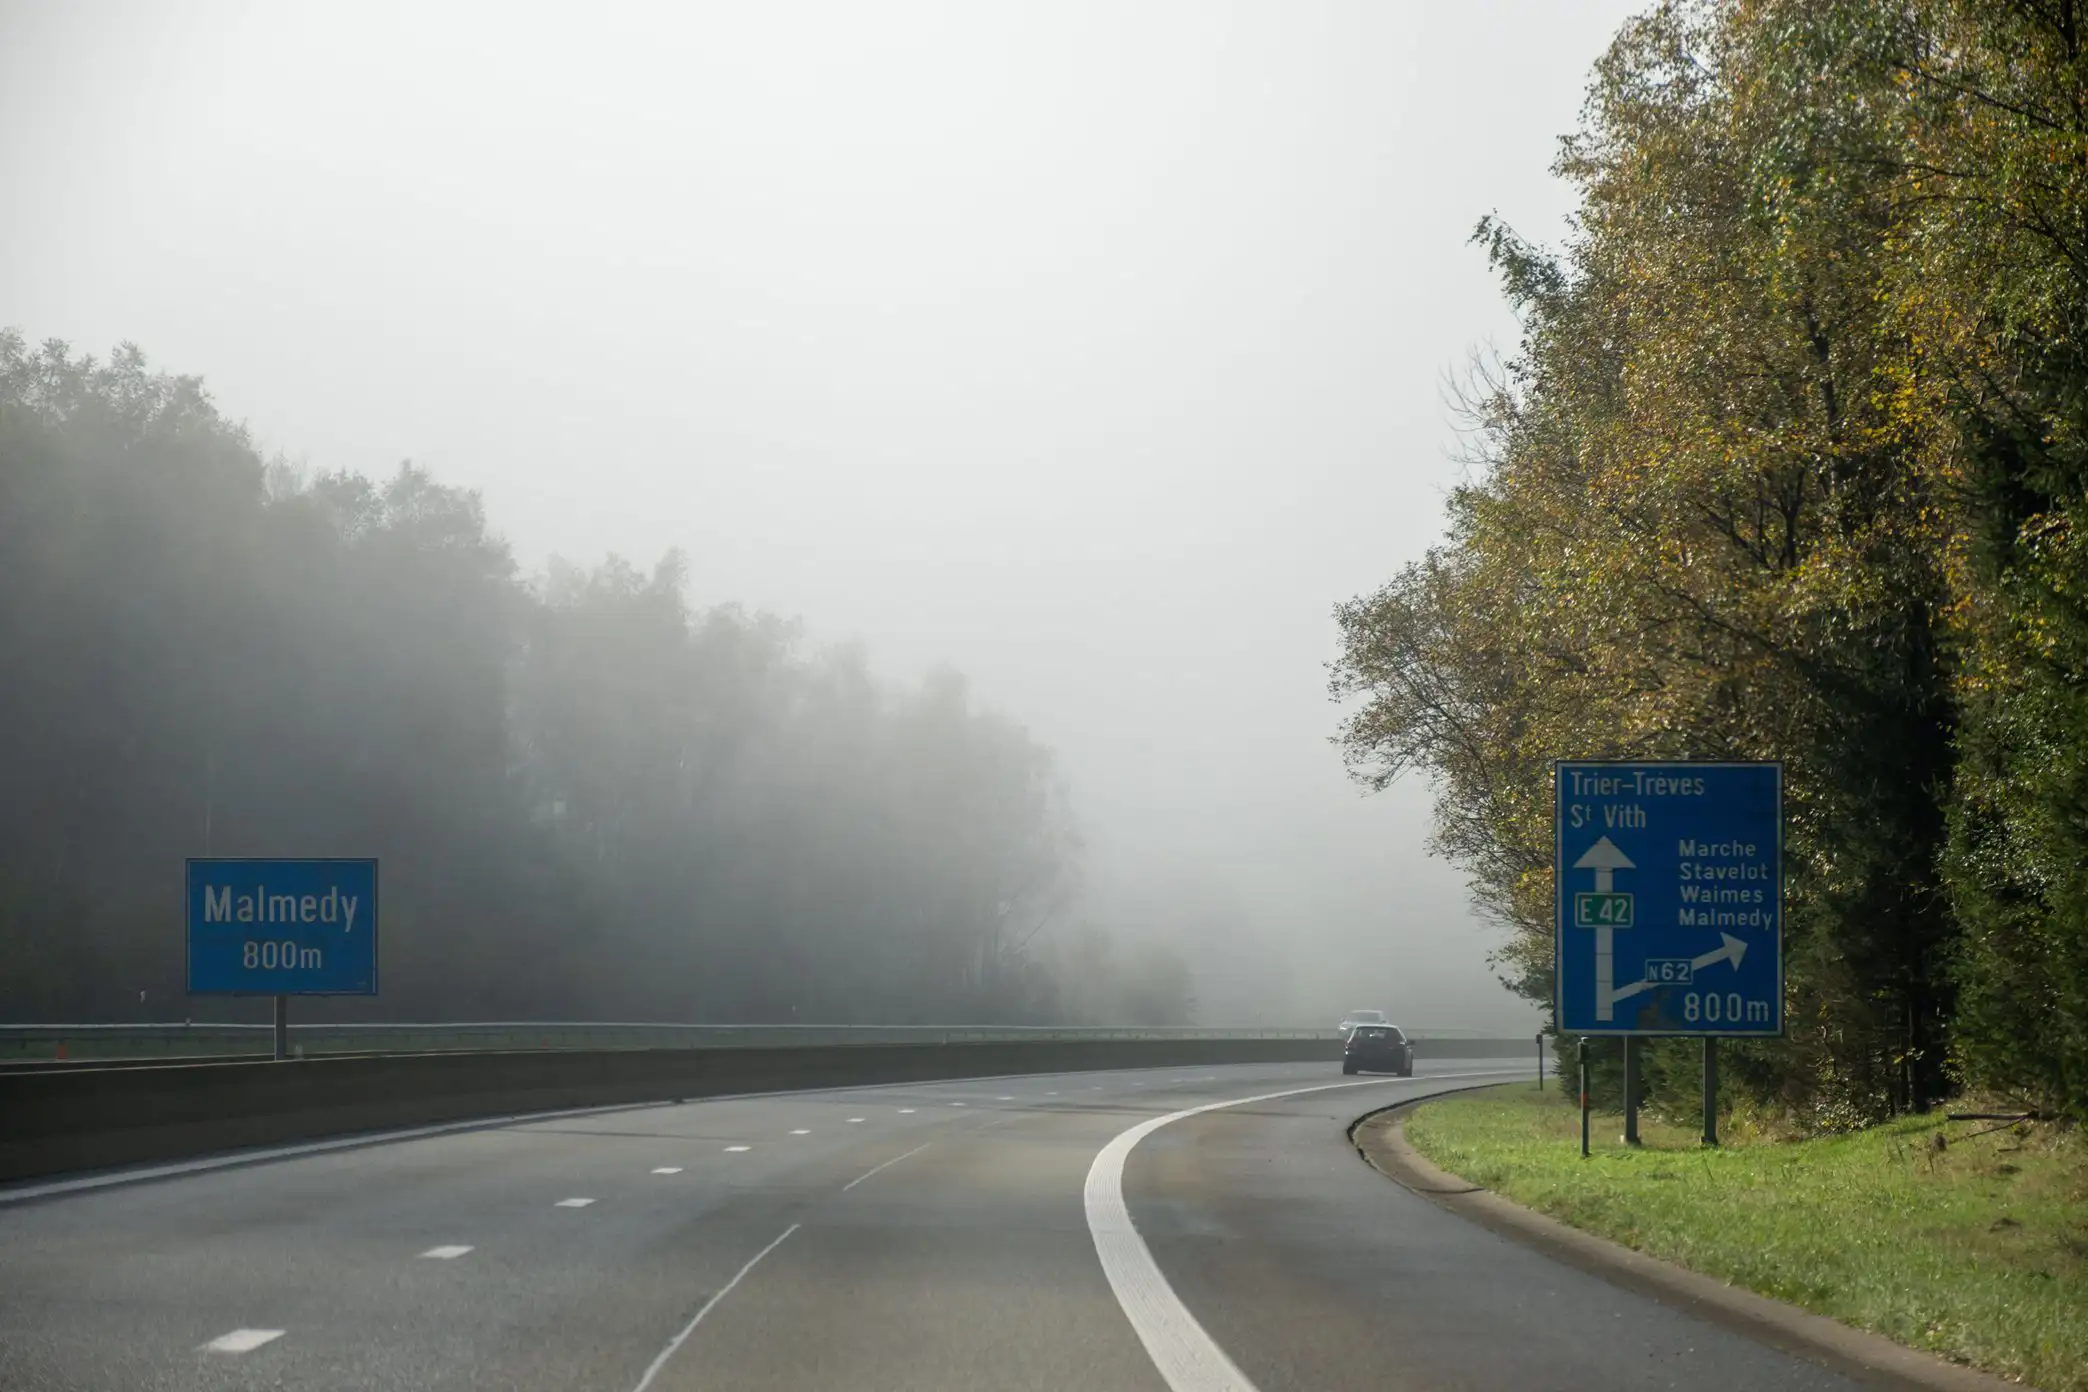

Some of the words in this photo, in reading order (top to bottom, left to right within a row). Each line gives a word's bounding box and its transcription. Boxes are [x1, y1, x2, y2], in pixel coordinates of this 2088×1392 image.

[1603, 804, 1647, 828] Vith
[1679, 840, 1756, 857] Marche
[1679, 862, 1769, 880] Stavelot
[1680, 886, 1763, 903] Waimes
[204, 885, 358, 933] Malmedy
[1679, 909, 1773, 931] Malmedy
[243, 940, 322, 970] 800m
[1648, 962, 1690, 981] N62
[1684, 992, 1769, 1022] 800m
